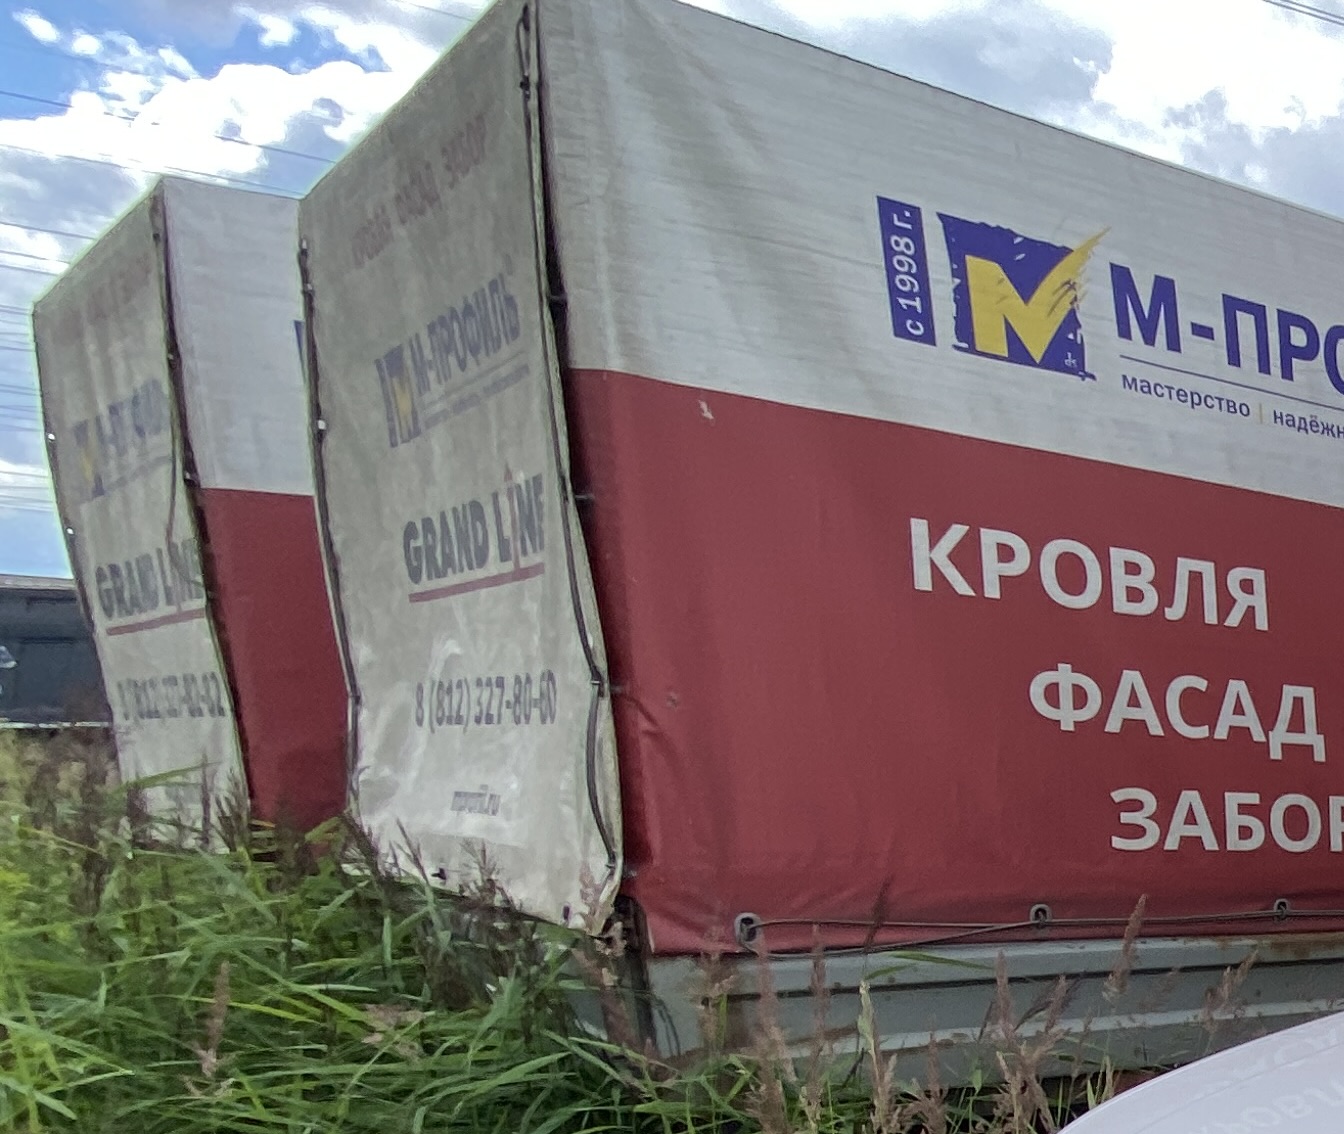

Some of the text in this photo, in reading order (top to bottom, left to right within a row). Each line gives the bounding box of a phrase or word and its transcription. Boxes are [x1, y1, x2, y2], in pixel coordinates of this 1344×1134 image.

[889, 234, 922, 315] 1998
[1121, 374, 1251, 417] мастерство
[403, 500, 490, 585] GRAND
[909, 517, 1269, 631] КРОВЛЯ
[1028, 663, 1327, 763] ФАСАД
